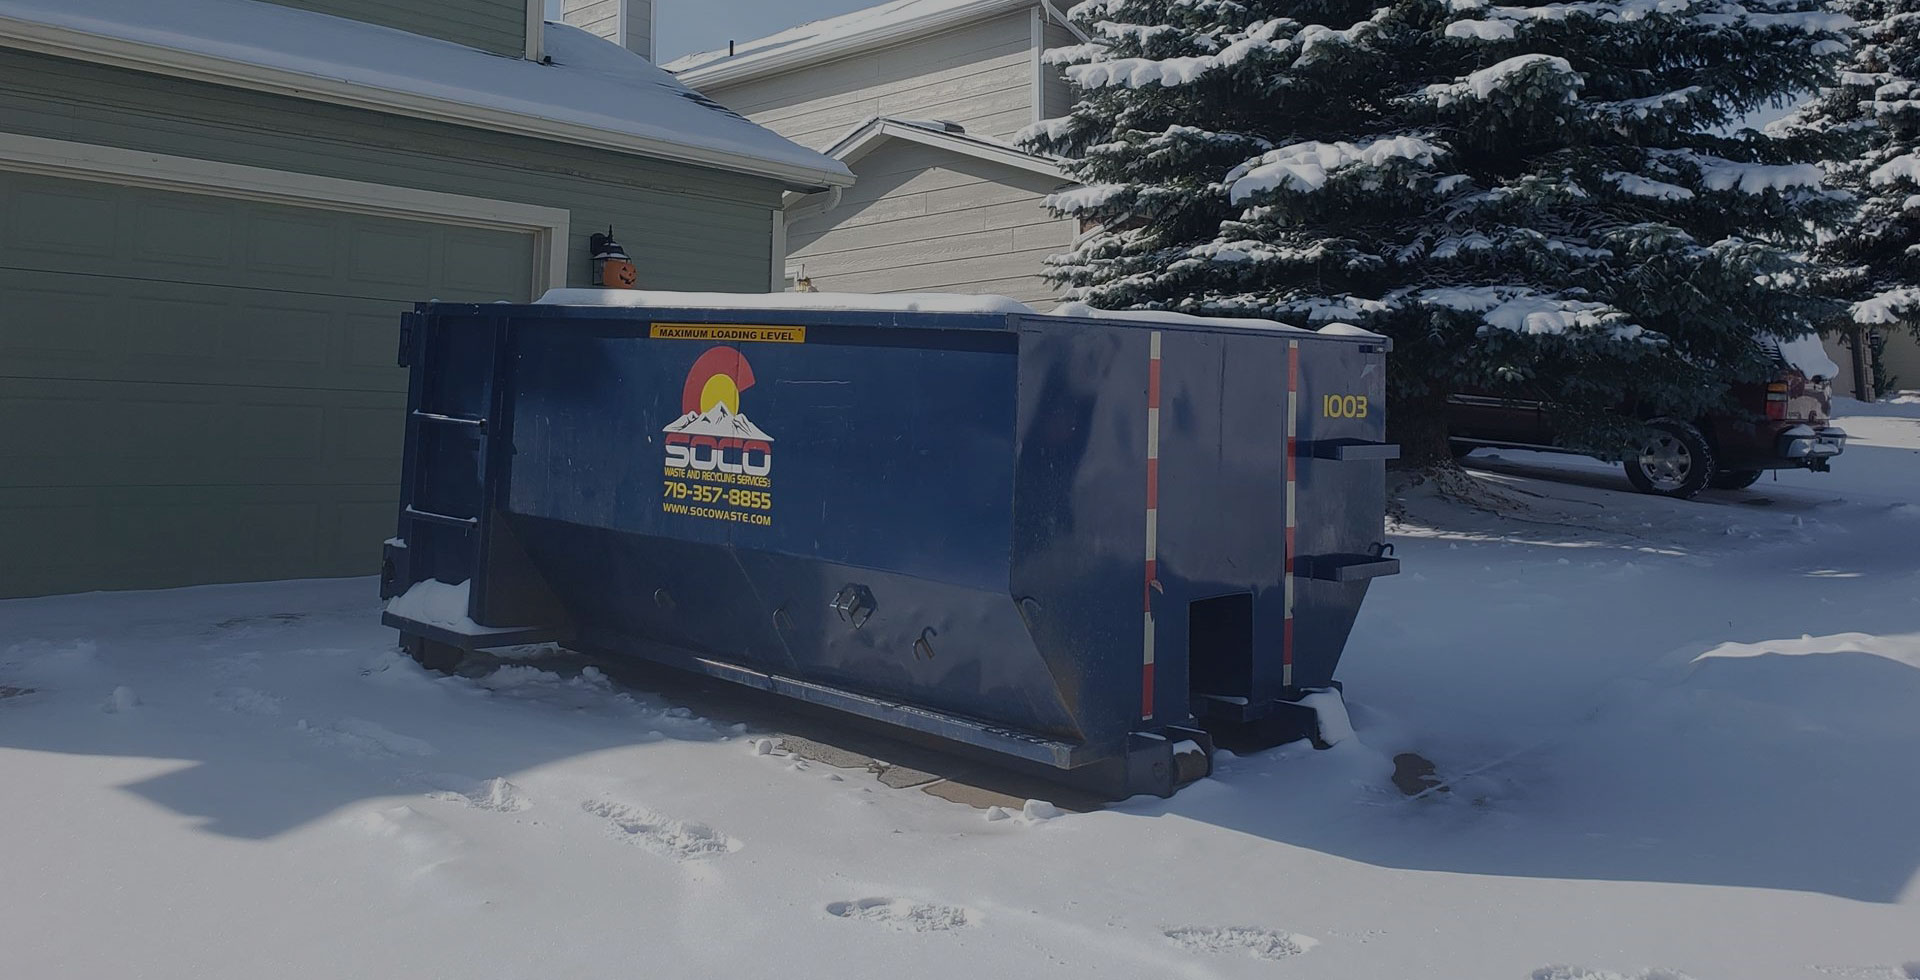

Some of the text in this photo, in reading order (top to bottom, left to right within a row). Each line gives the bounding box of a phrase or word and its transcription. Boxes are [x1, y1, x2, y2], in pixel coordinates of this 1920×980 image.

[659, 328, 794, 341] MAXIMUM LOADING LEVEL
[1323, 394, 1368, 418] 1003
[665, 433, 772, 476] SOCO
[664, 466, 686, 478] WASTE
[686, 469, 700, 480] AND
[701, 471, 736, 484] RECYCLING
[736, 475, 768, 487] SERVICES
[663, 480, 772, 510] 719-357-8855
[663, 502, 772, 526] WWW.SOCOWASTE.COM
